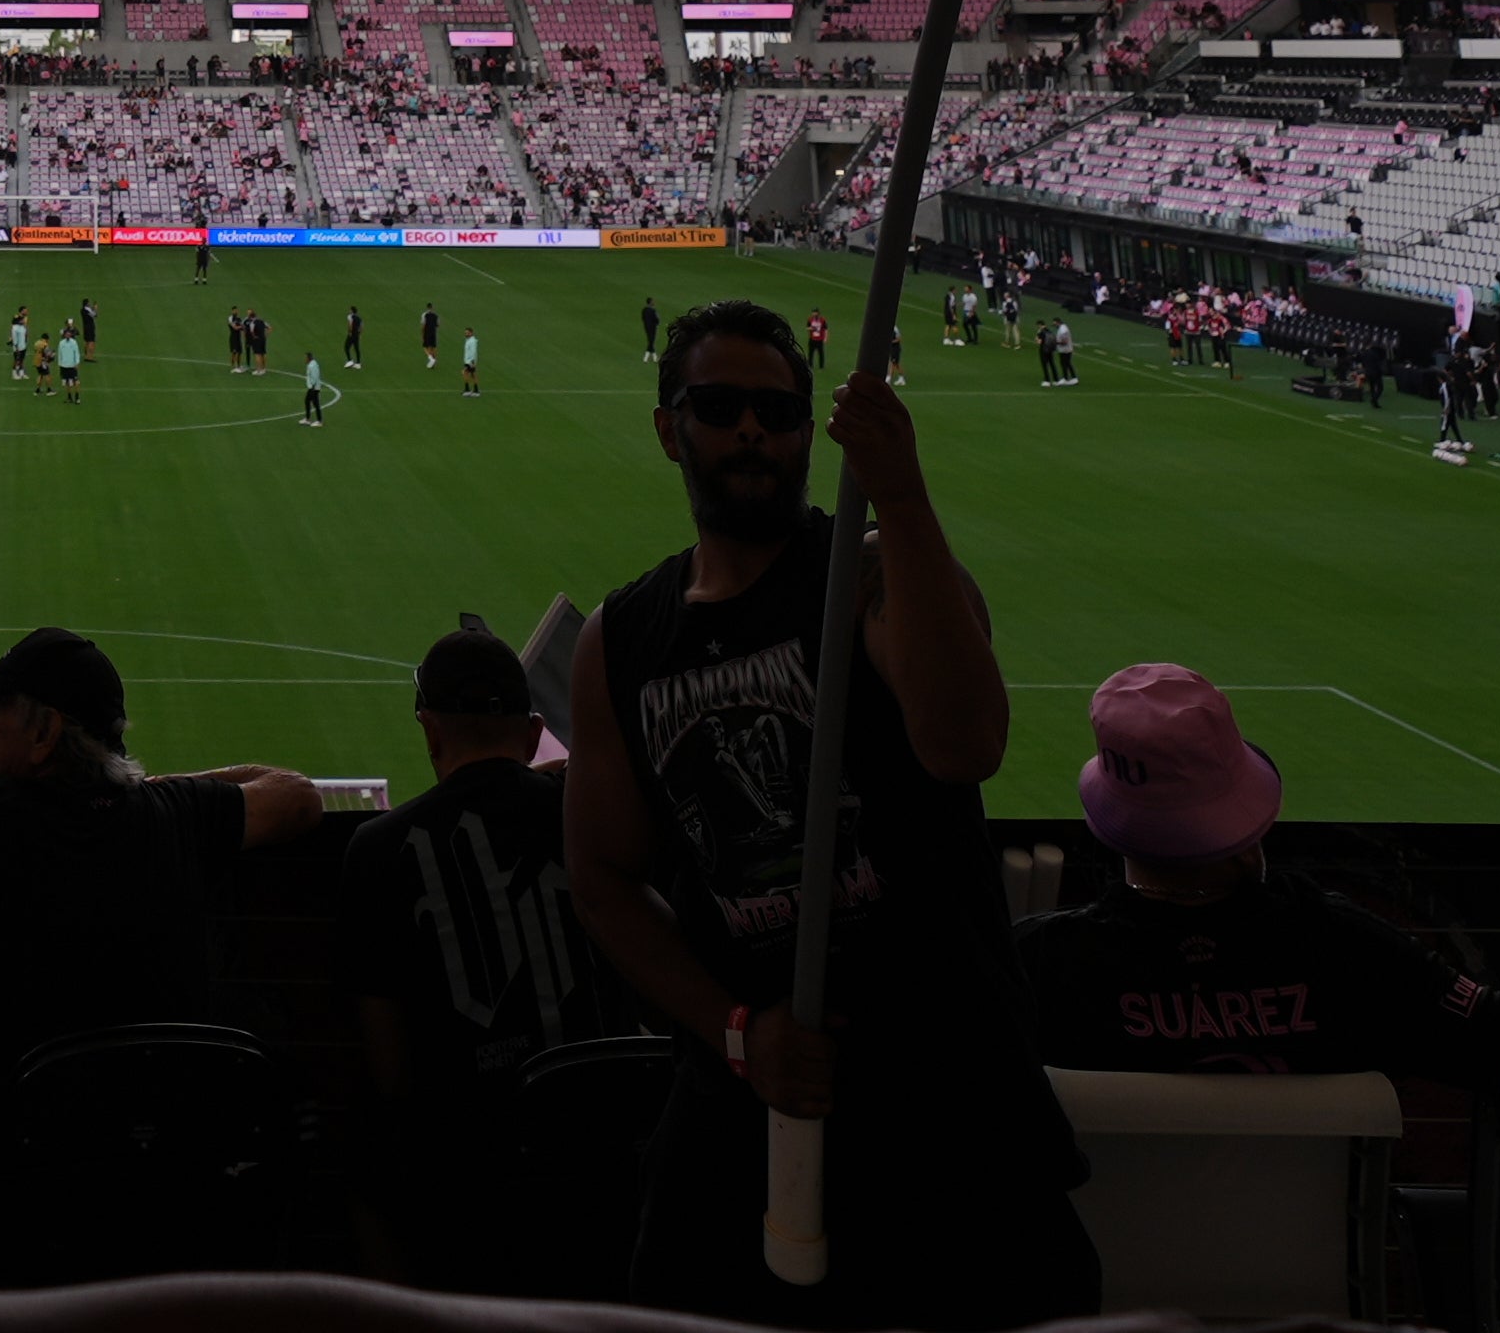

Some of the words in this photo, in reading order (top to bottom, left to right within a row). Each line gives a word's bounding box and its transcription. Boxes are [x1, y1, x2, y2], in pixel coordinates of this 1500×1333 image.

[83, 229, 109, 240] Tre
[114, 230, 144, 241] Audi
[217, 231, 295, 243] ticketmaster
[310, 232, 350, 242] Florida
[405, 232, 445, 243] ERGO
[611, 231, 677, 245] Continental
[688, 230, 716, 243] Tire
[1119, 981, 1319, 1040] SUÁREZ
